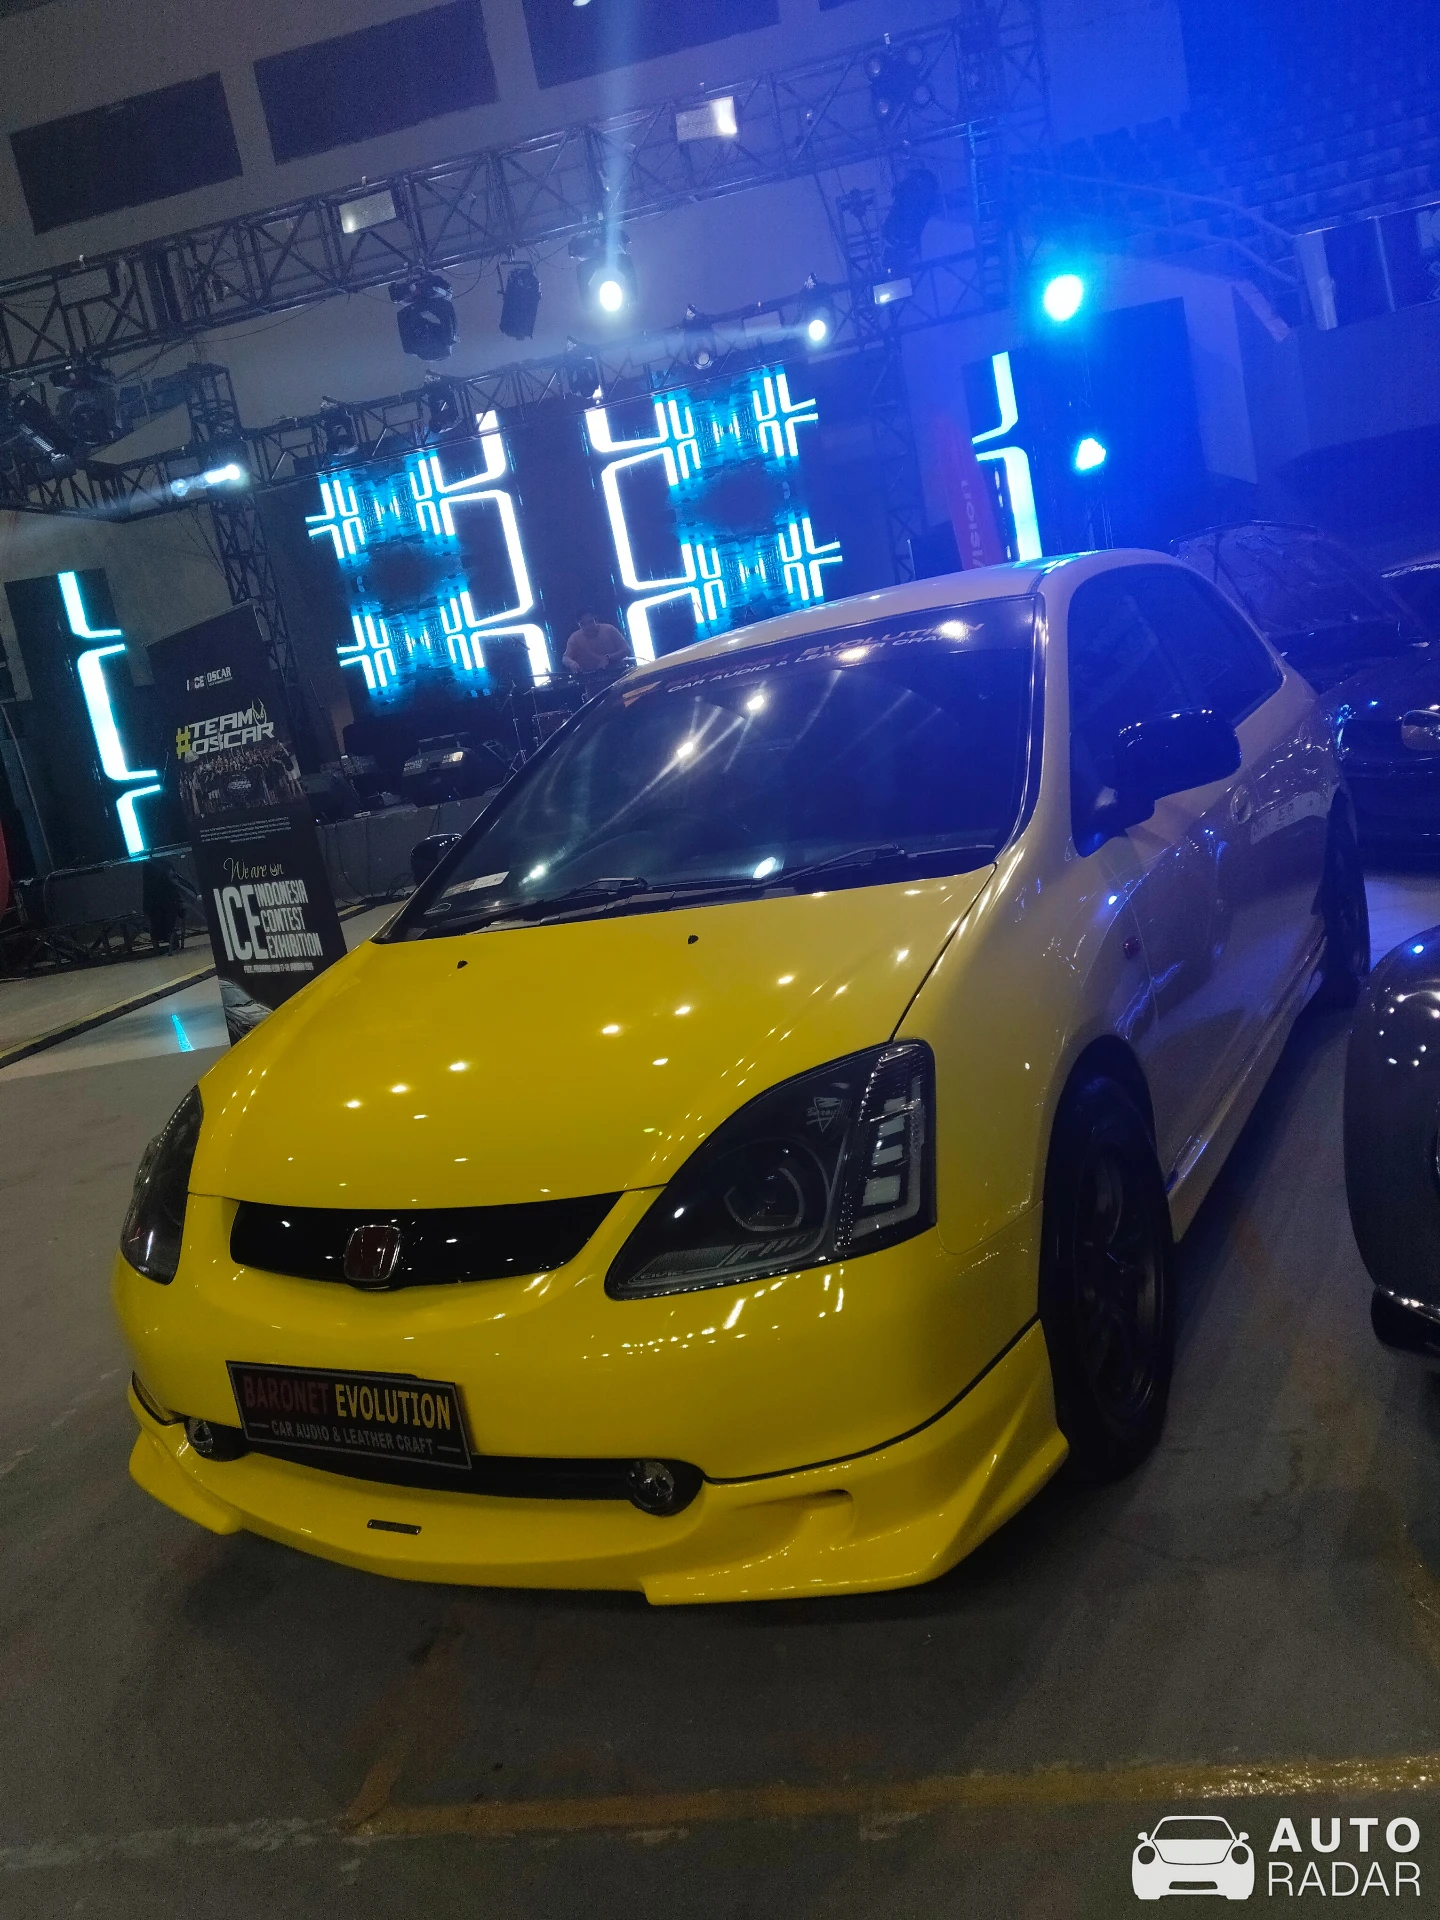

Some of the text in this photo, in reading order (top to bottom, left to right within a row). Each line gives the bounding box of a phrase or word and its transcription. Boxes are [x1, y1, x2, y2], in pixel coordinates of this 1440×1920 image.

[801, 622, 985, 656] EVOLUTIN
[206, 666, 232, 683] OSCAR
[667, 679, 706, 693] CAR
[709, 664, 771, 683] AUDIO
[794, 641, 885, 664] LEATR
[191, 721, 275, 756] OSCAR
[223, 857, 250, 882] We
[250, 864, 268, 879] are
[253, 879, 309, 908] INDONESIA
[212, 884, 269, 962] ICE
[260, 906, 306, 934] CONTEST
[265, 932, 324, 959] EXHIBITION
[242, 1374, 451, 1431] BARONET EVOLUTION
[271, 1419, 433, 1456] CAR AUDIO & LEATHER CRAFT
